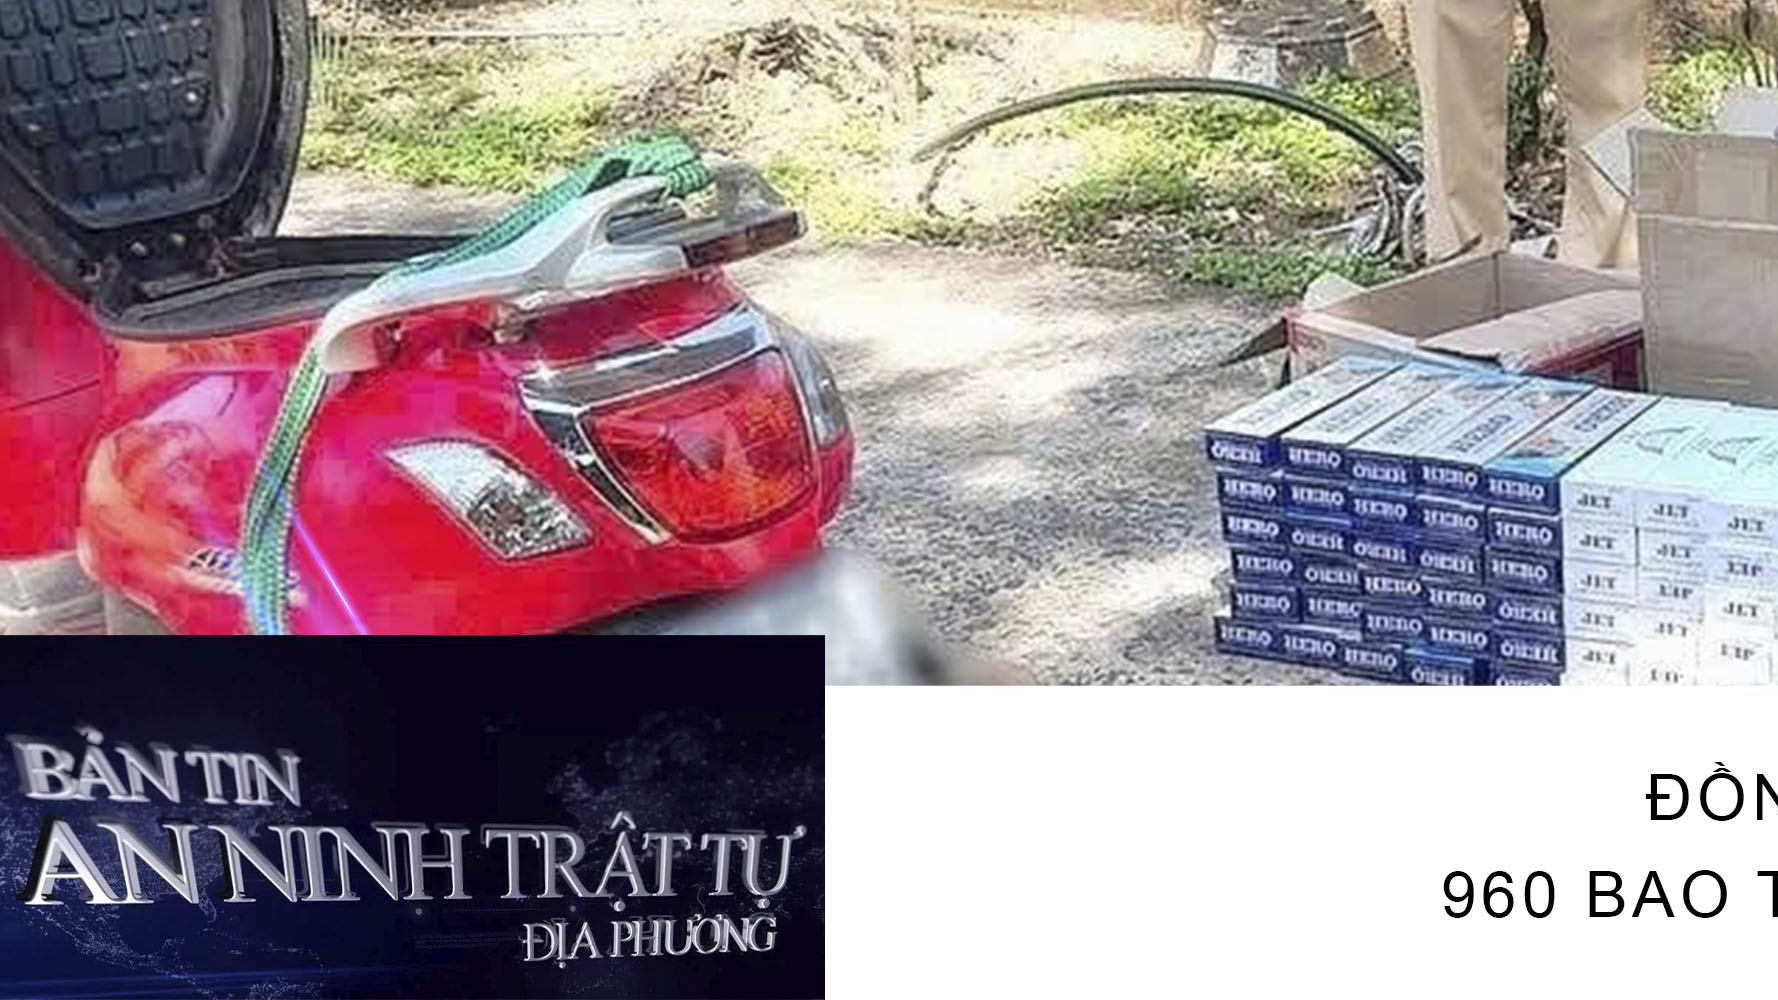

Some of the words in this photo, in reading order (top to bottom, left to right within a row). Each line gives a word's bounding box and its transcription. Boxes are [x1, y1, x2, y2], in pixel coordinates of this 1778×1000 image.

[1289, 448, 1341, 467] HERO
[1353, 463, 1408, 483] HERO
[1422, 465, 1478, 488] HERO
[1223, 478, 1276, 500] HERO
[1291, 486, 1344, 505] HERO
[1489, 478, 1545, 500] HERO
[1354, 499, 1407, 520] HERO
[1423, 509, 1479, 530] HERO
[1227, 516, 1279, 536] HERO
[1496, 521, 1552, 544] HERO
[1237, 554, 1293, 575] HERO
[1492, 559, 1547, 582] HERO
[1364, 576, 1421, 594] HERO
[1237, 593, 1290, 612] HERO
[1429, 588, 1486, 609] HERO
[1430, 627, 1487, 649] HERO
